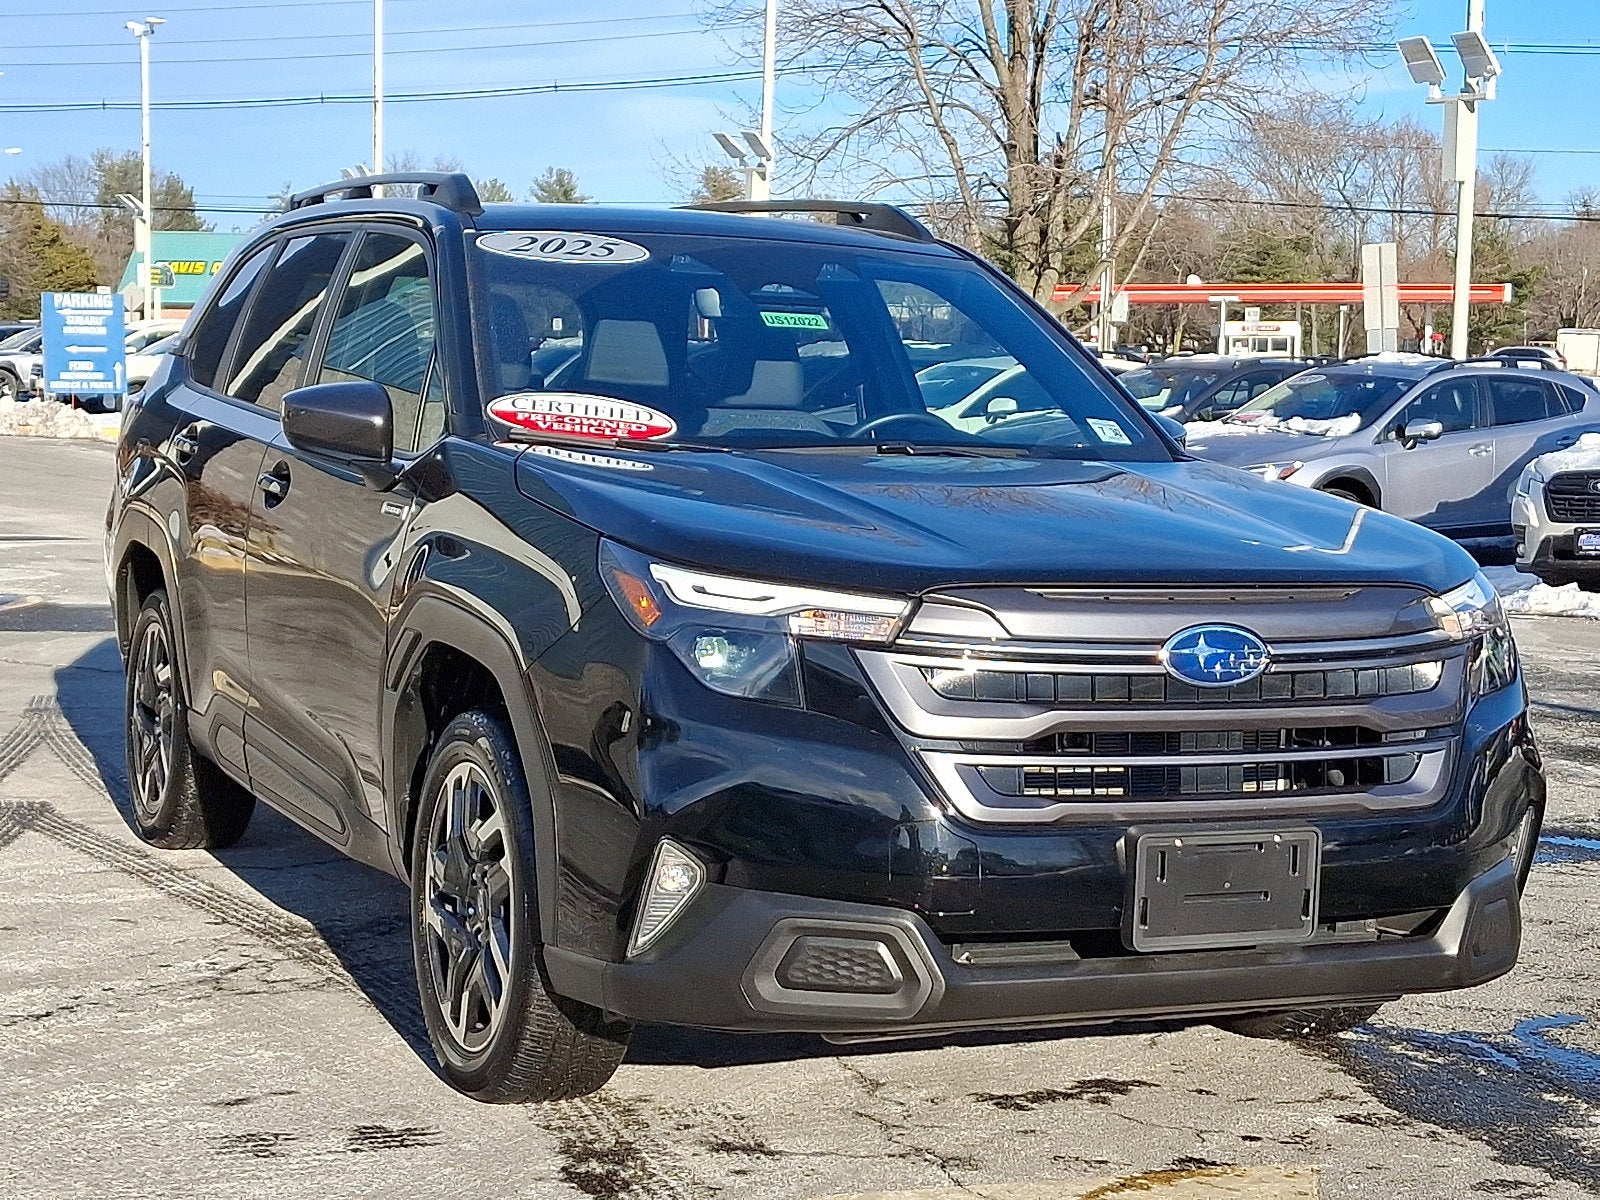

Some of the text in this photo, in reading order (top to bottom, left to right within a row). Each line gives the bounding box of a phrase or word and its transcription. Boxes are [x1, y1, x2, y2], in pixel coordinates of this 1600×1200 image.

[509, 236, 620, 257] 2025
[53, 293, 113, 308] PARKING
[763, 315, 822, 326] US12022
[512, 397, 653, 422] CERTIFIED
[516, 411, 648, 432] PRE-OWNED
[537, 421, 629, 437] VEHICLE
